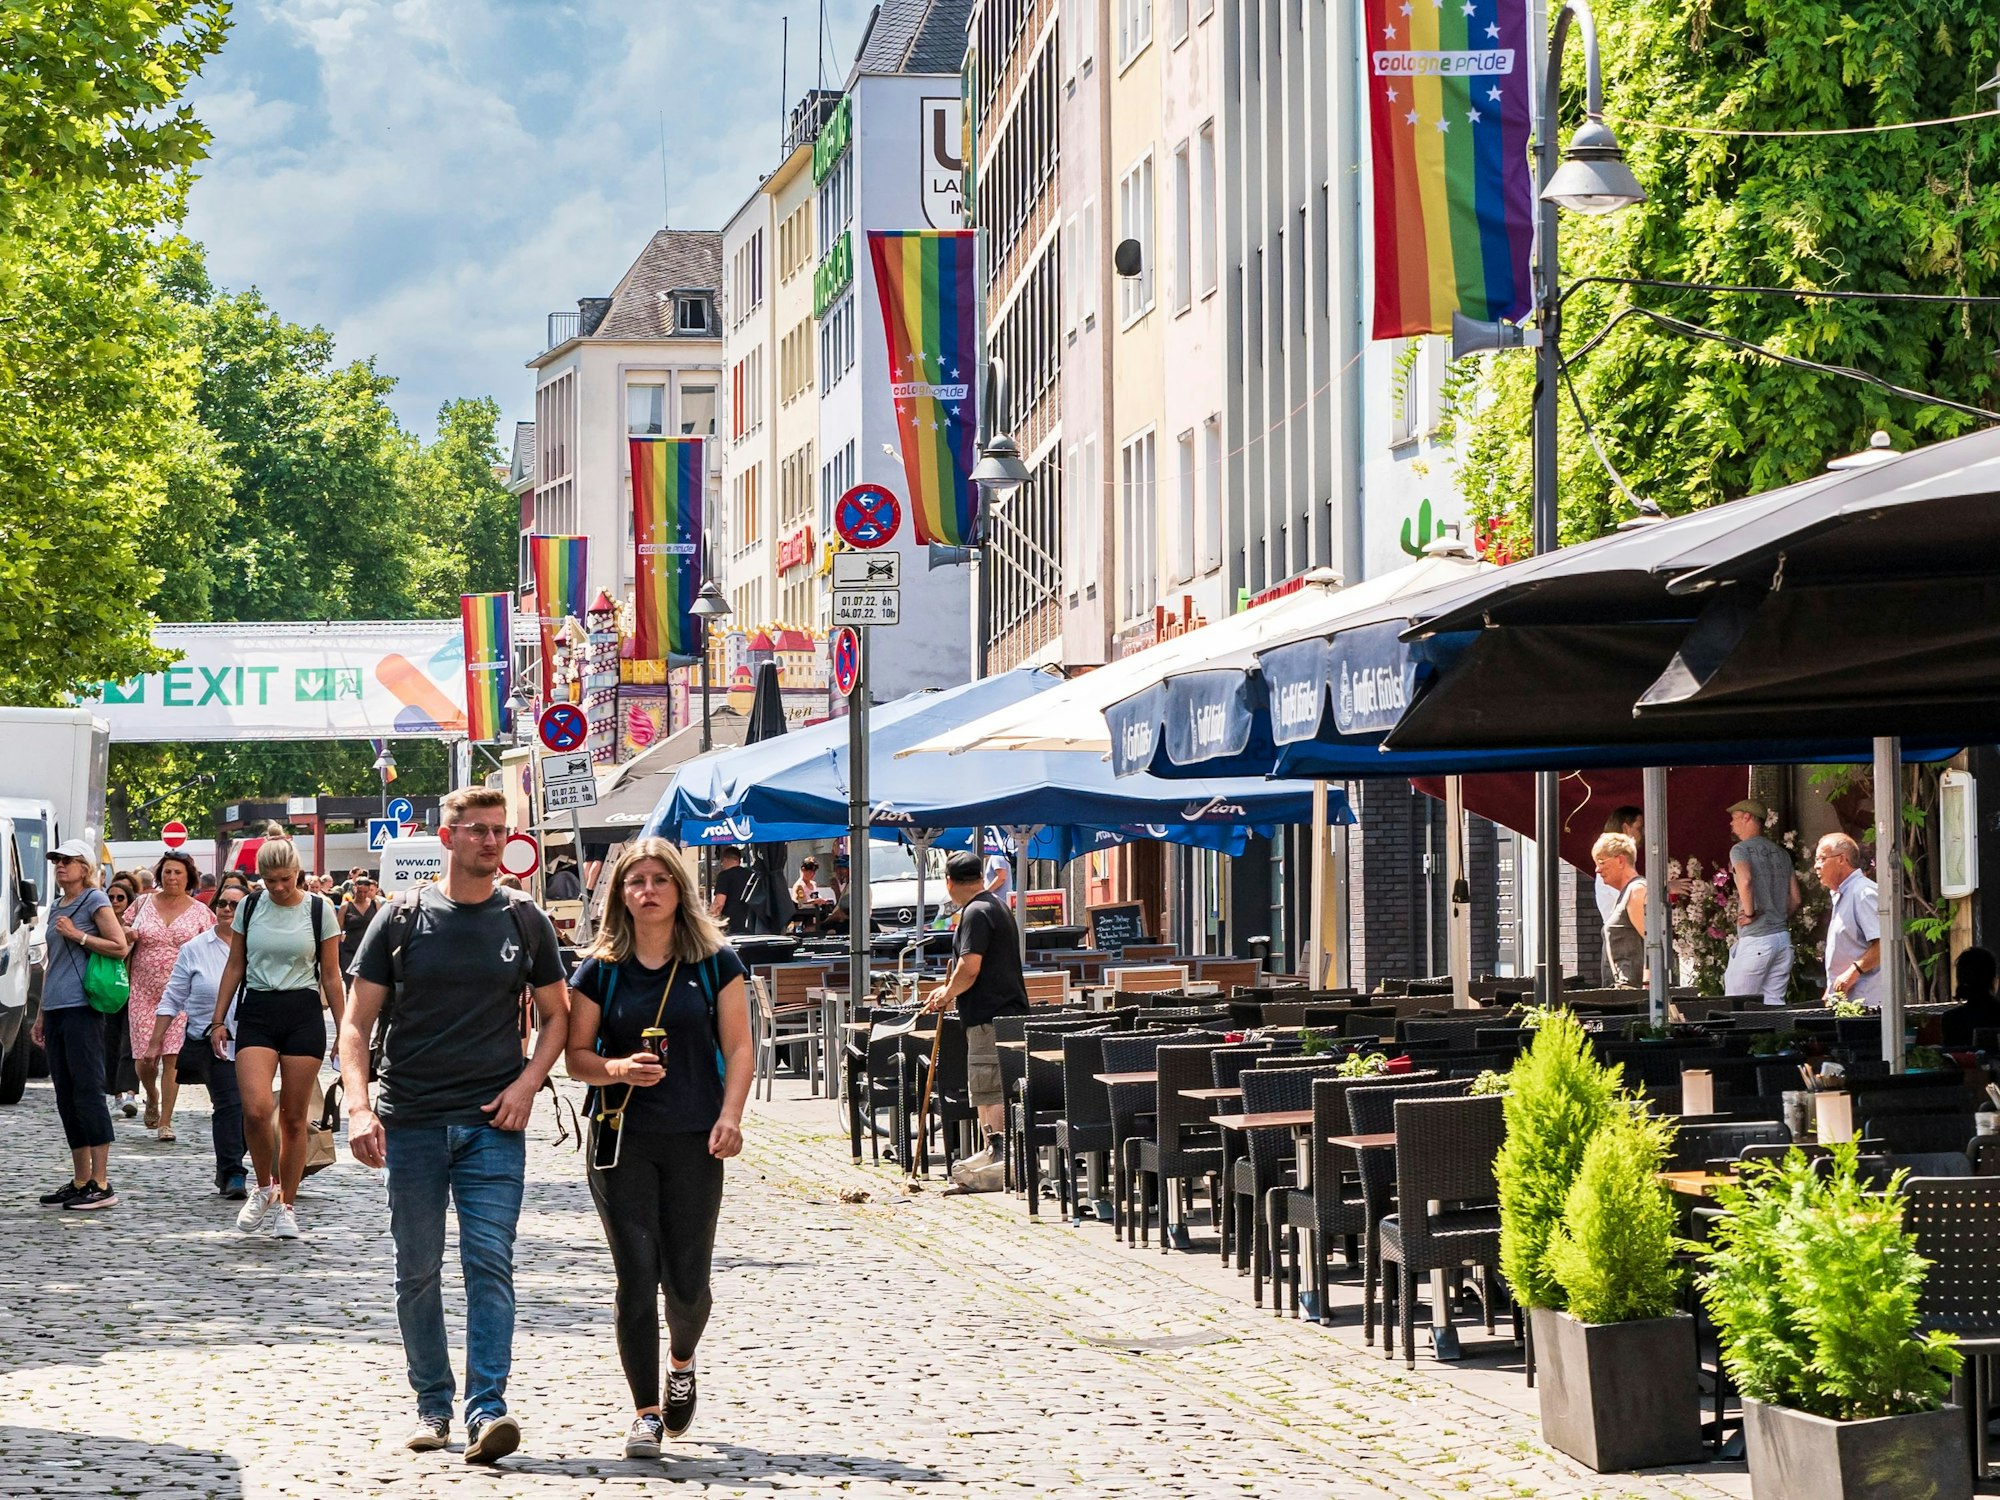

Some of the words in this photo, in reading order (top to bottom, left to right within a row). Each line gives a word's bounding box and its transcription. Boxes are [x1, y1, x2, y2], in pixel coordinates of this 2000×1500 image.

[1379, 54, 1451, 73] cologne
[1455, 52, 1507, 71] pride
[934, 179, 963, 193] LA
[893, 384, 933, 397] cologn
[882, 596, 893, 606] 6h
[882, 608, 896, 618] 10h
[163, 666, 279, 706] EXIT
